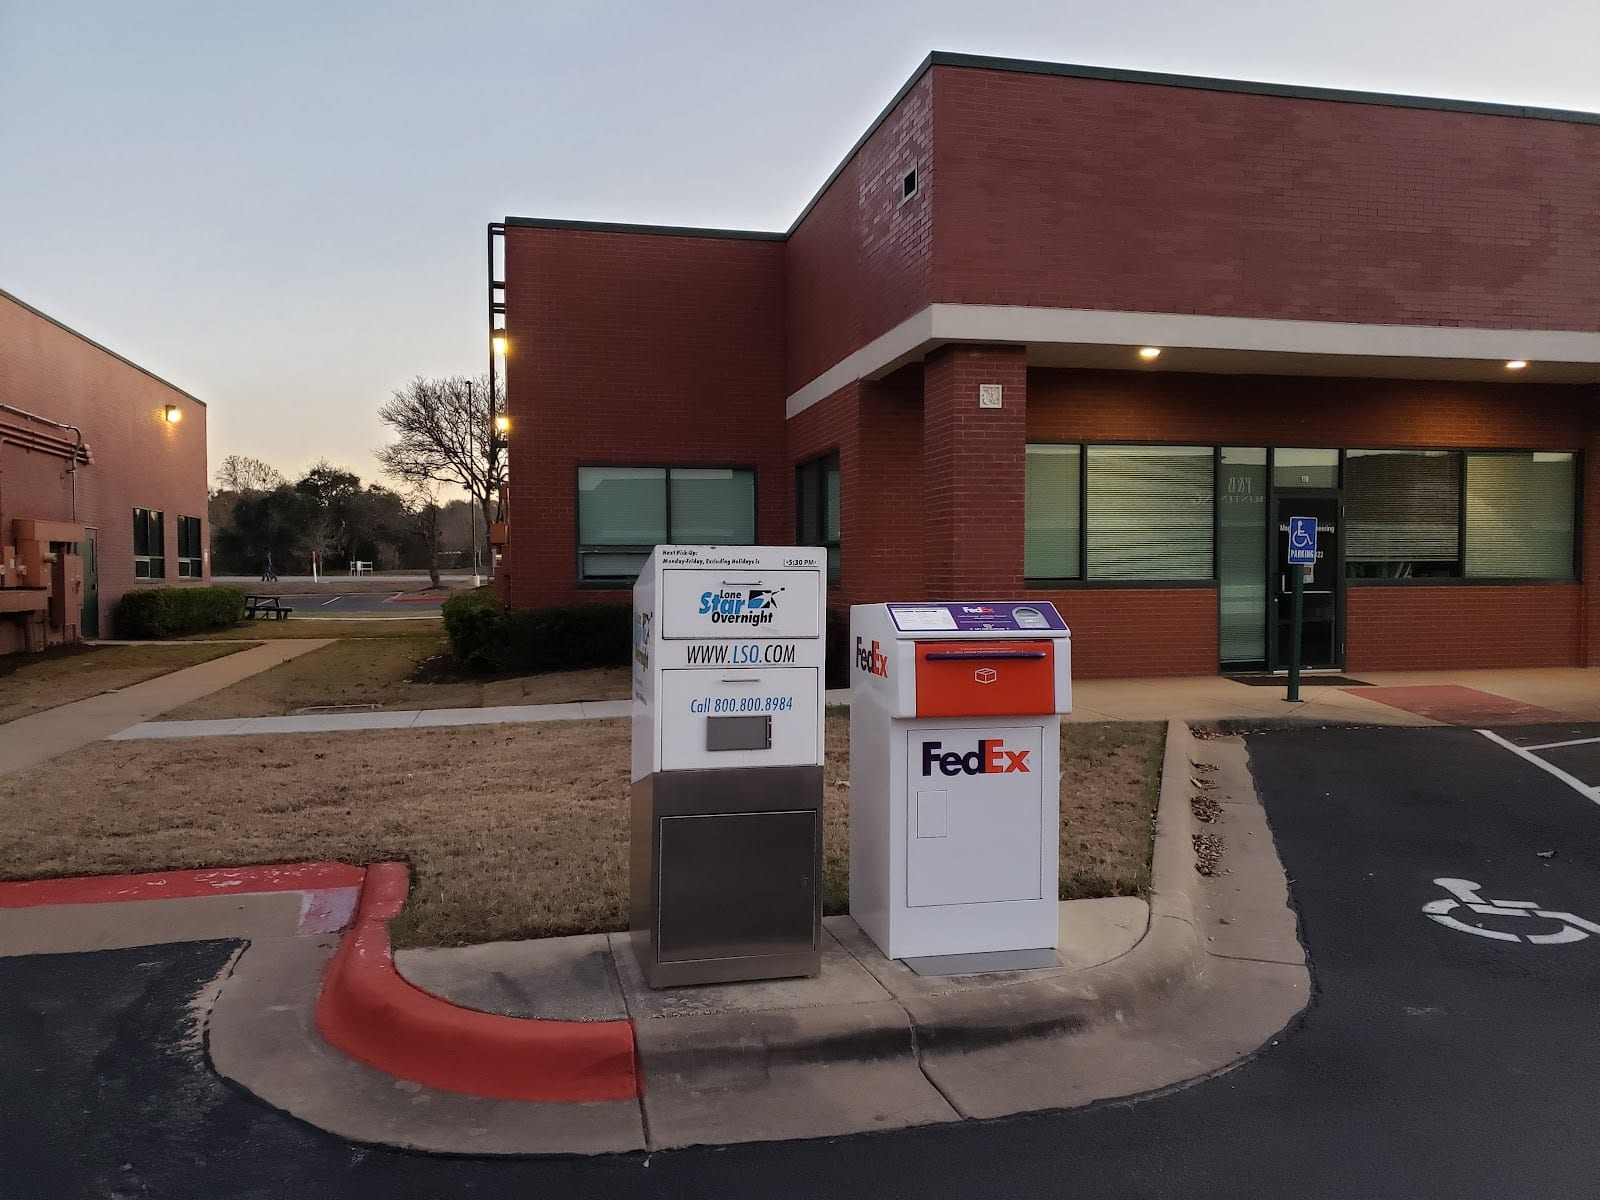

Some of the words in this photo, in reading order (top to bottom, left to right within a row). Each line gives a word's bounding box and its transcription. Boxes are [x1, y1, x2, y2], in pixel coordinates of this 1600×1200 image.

[1290, 549, 1314, 559] PARKING
[699, 591, 746, 614] Star
[720, 589, 742, 599] Lone
[962, 605, 994, 614] FedEx
[712, 610, 773, 627] Overnight
[687, 644, 796, 664] WWW.LSO.COM
[856, 635, 888, 679] FedEx
[690, 697, 711, 713] Call
[714, 696, 793, 713] 800.800.8984
[922, 739, 1031, 777] FedEx
